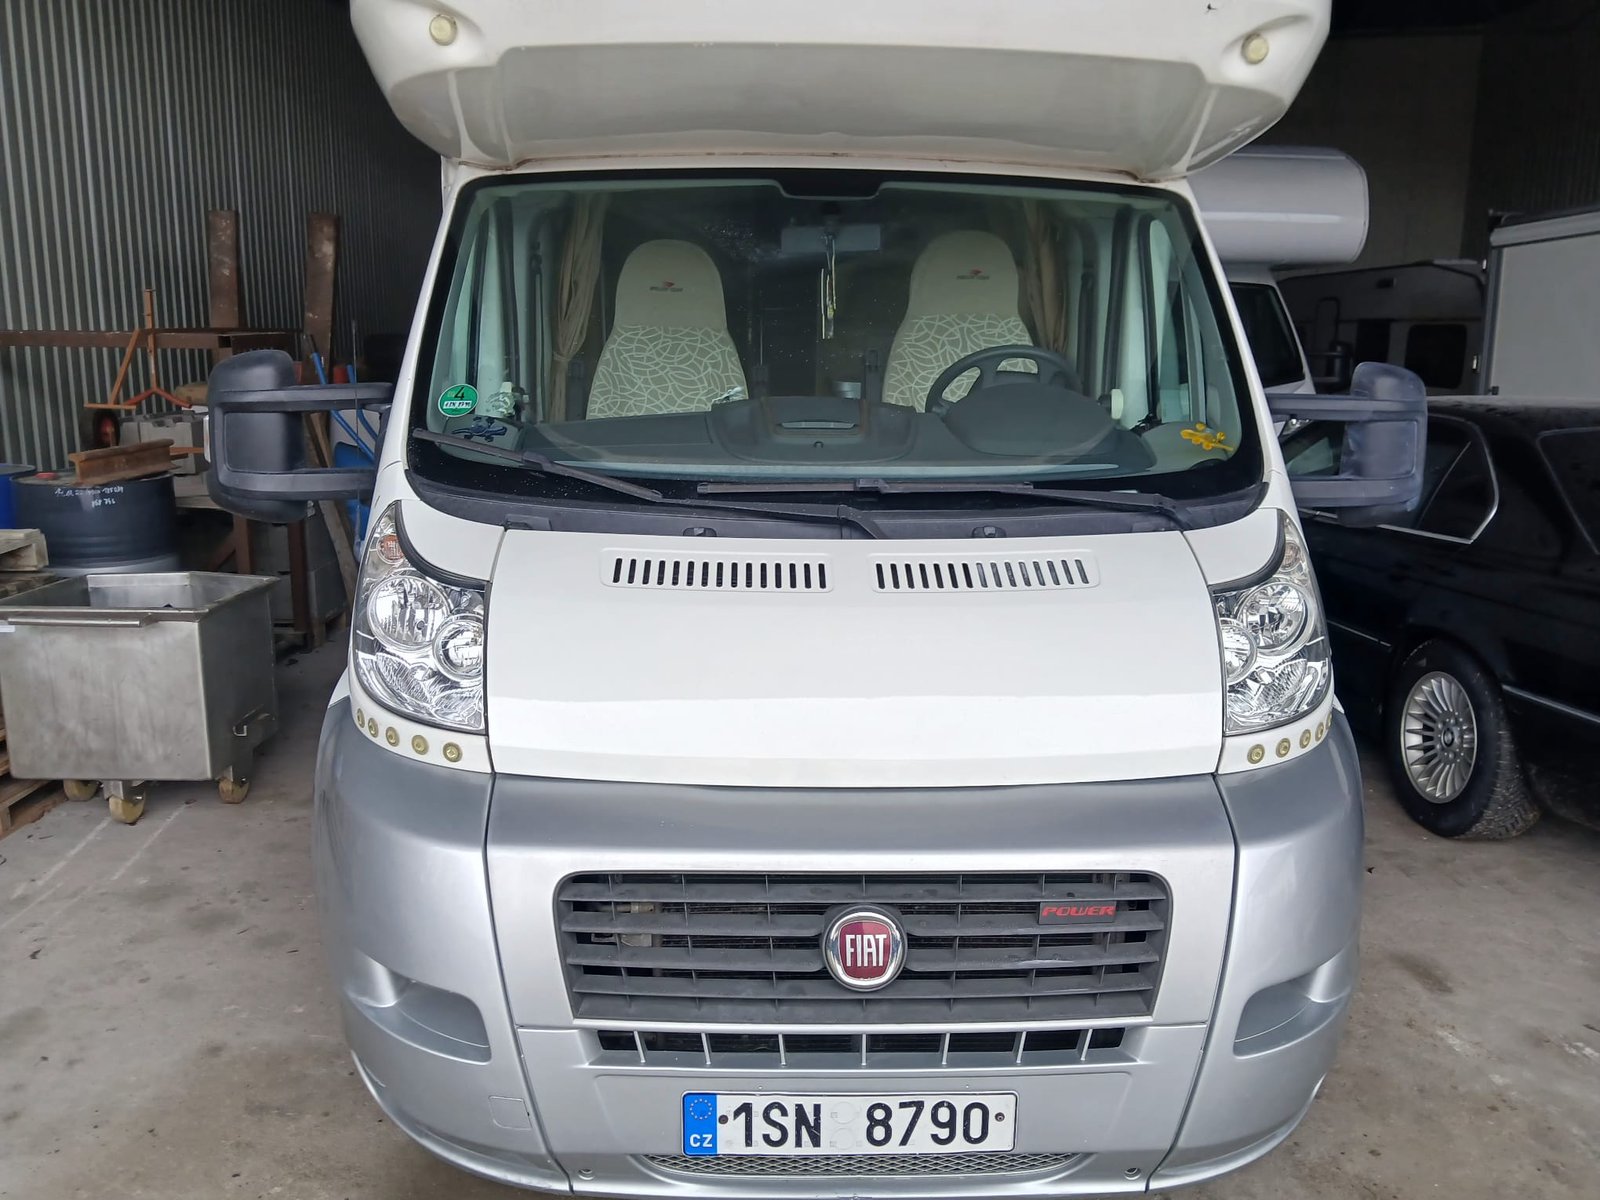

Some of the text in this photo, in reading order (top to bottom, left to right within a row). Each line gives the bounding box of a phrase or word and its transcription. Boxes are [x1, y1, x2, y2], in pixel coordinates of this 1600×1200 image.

[454, 387, 465, 400] 4
[1042, 905, 1116, 917] POWER
[845, 934, 887, 967] FIAT
[733, 1100, 990, 1148] 1SN 8790
[689, 1134, 713, 1148] CZ
